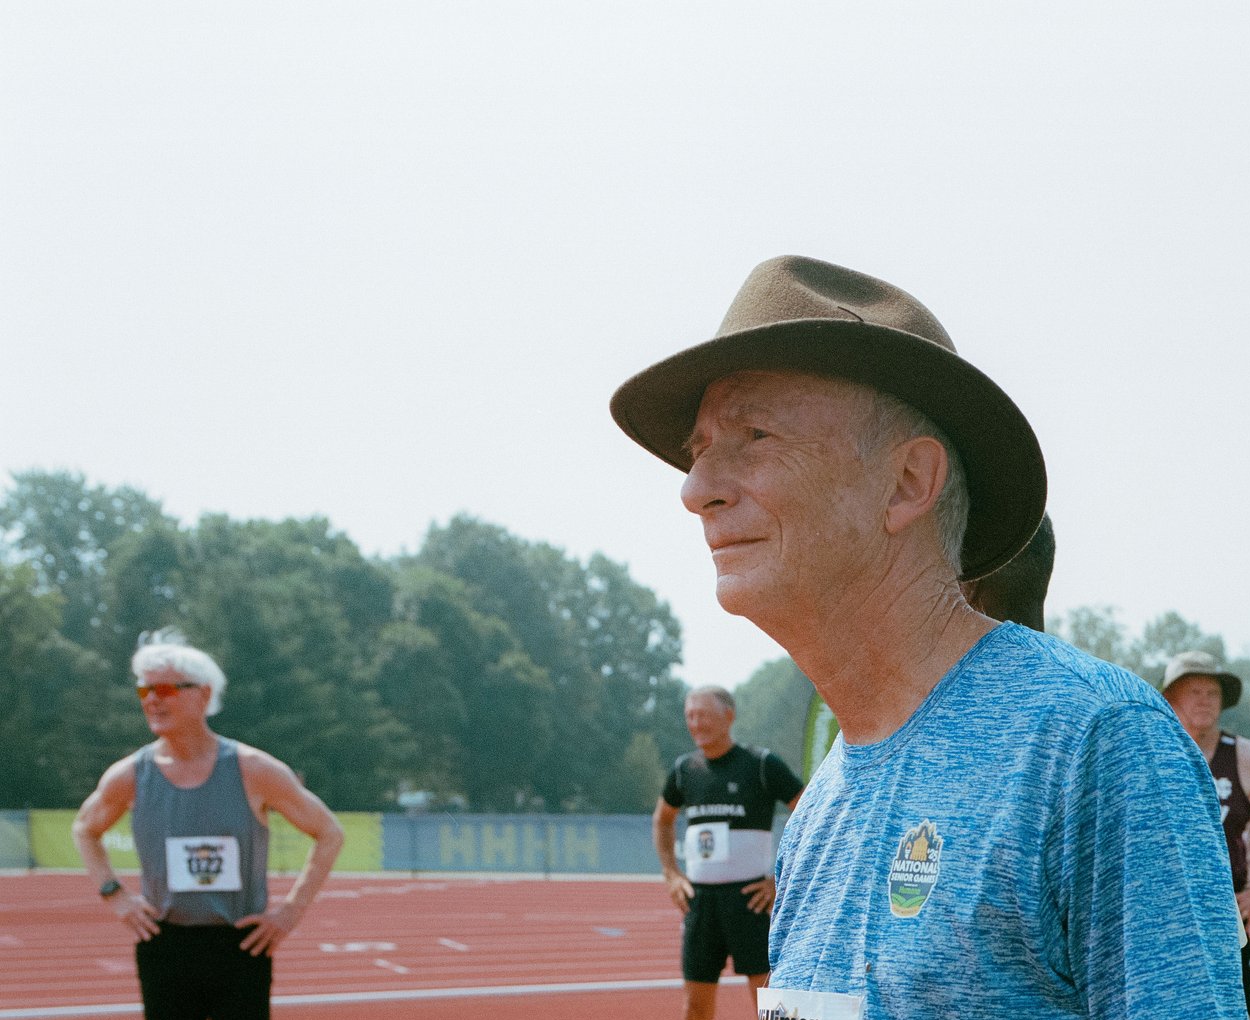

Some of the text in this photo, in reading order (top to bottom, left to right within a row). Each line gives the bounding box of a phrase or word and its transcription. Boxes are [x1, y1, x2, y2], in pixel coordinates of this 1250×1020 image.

[893, 859, 938, 874] NATIONAL
[891, 872, 936, 884] SENIOR GAMES
